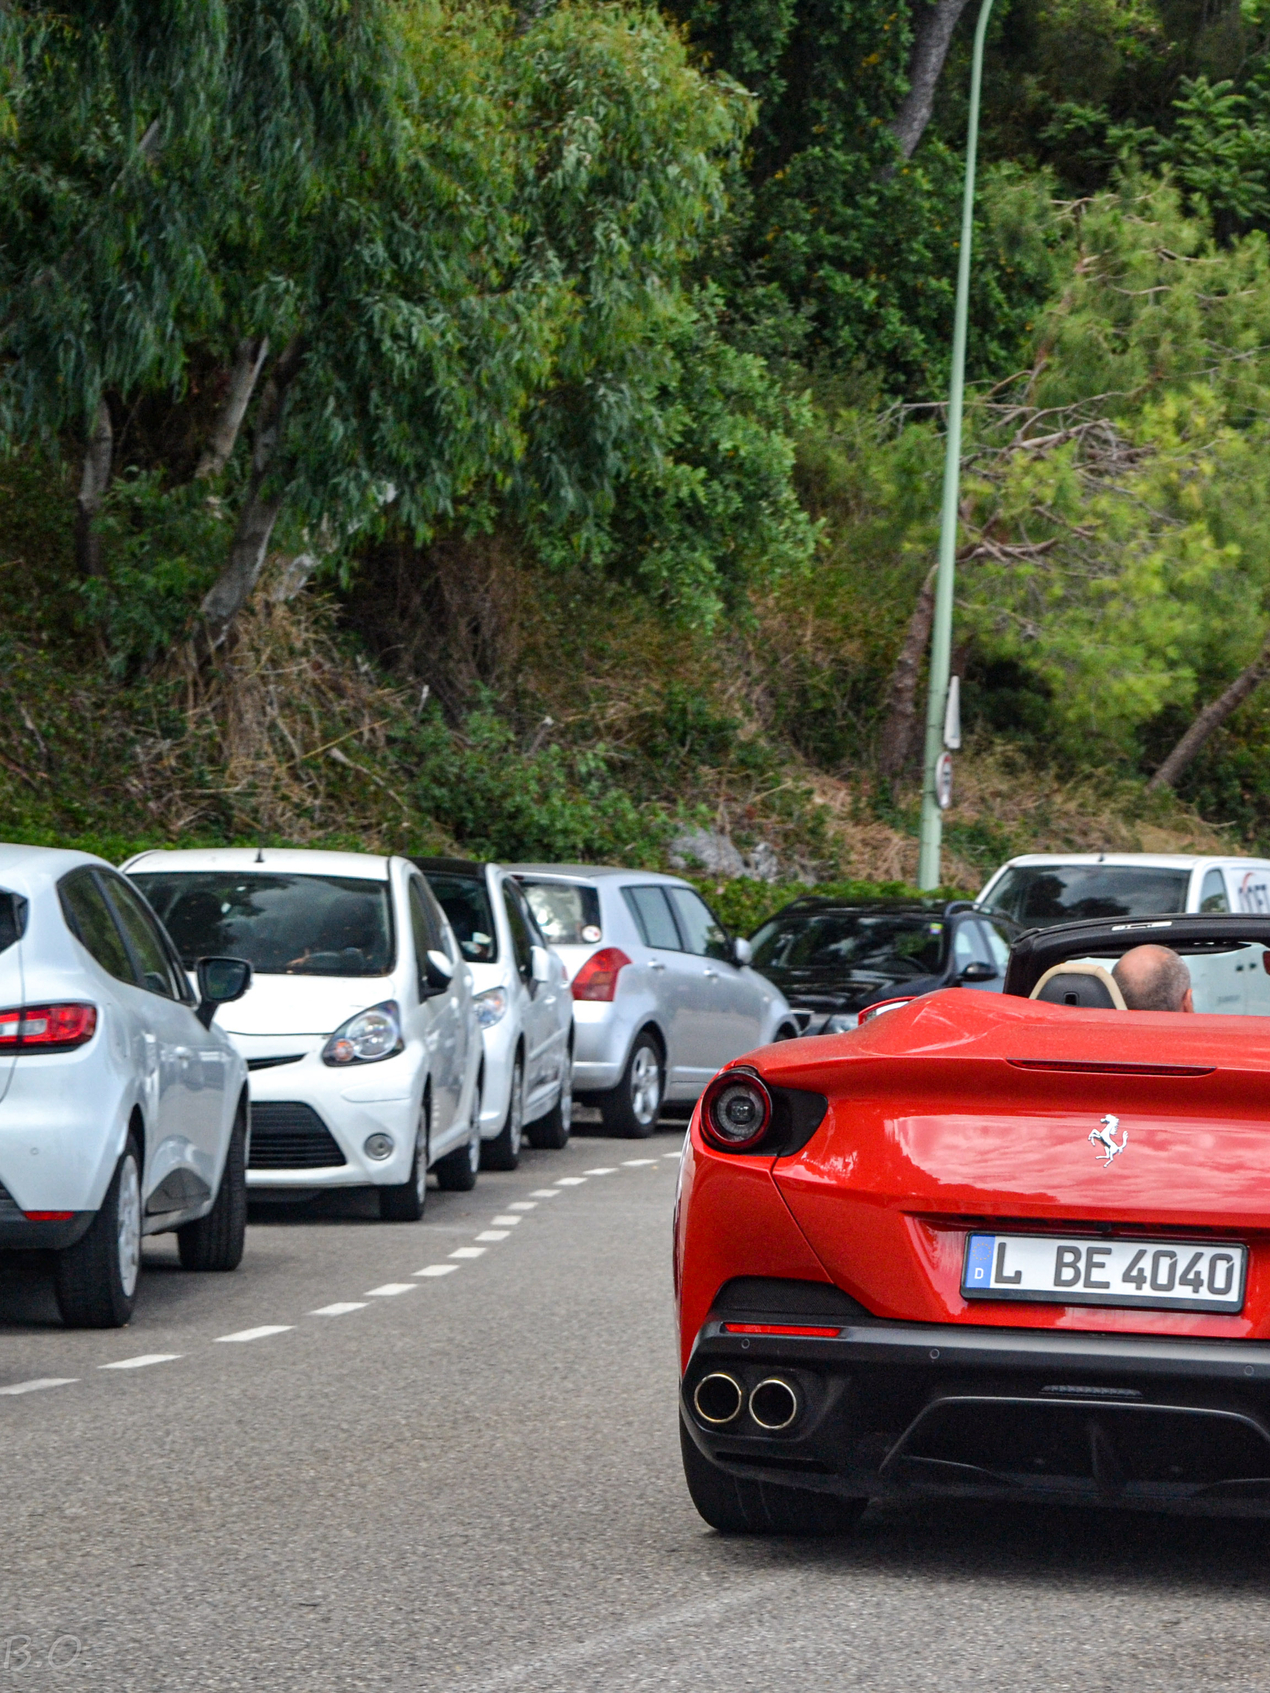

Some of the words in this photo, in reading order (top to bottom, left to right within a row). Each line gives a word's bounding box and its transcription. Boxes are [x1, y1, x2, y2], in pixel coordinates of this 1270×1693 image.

[974, 1268, 984, 1280] D
[995, 1242, 1022, 1284] L
[1054, 1246, 1112, 1290] BE
[1122, 1249, 1234, 1295] 4040
